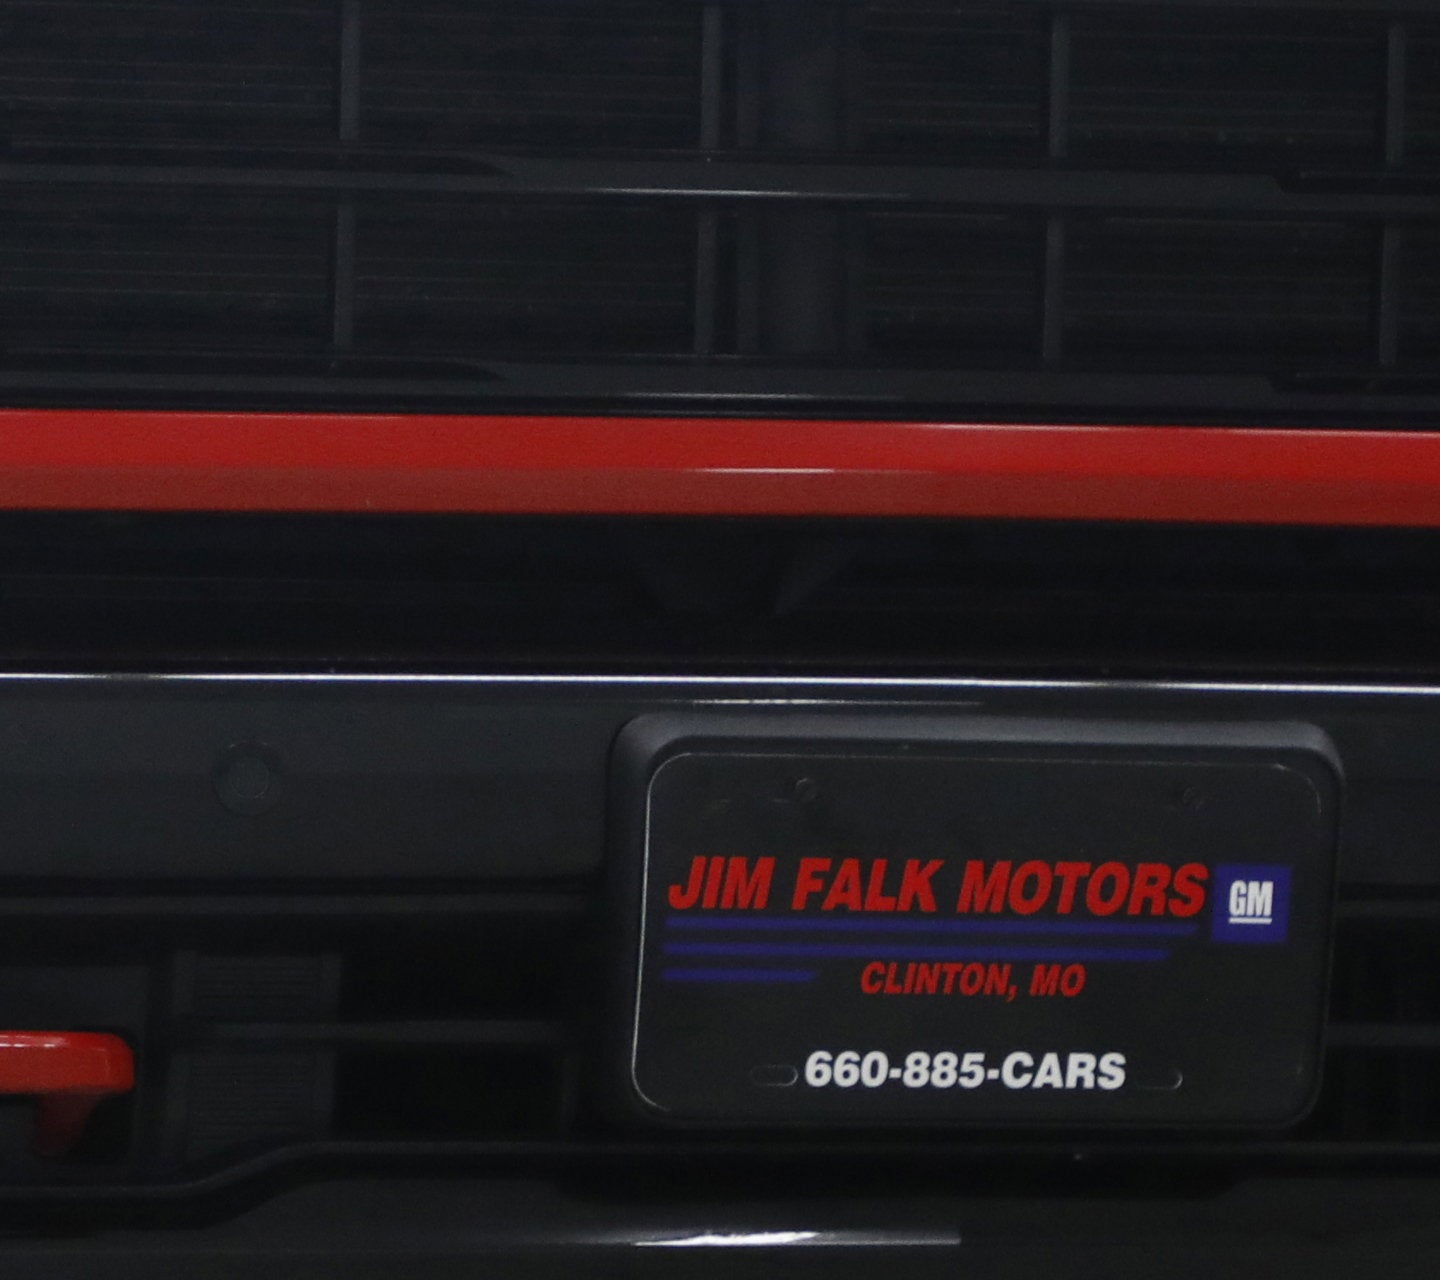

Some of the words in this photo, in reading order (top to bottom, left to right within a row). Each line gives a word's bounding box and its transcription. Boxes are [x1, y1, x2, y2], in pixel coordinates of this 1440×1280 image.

[667, 856, 776, 910] JIM
[791, 857, 945, 912] FALK
[956, 861, 1209, 917] MOTORS
[1228, 880, 1273, 919] GM
[860, 962, 1020, 1003] CLINTON,
[1029, 963, 1086, 997] MO
[805, 1051, 1127, 1090] 660-885-CARS
